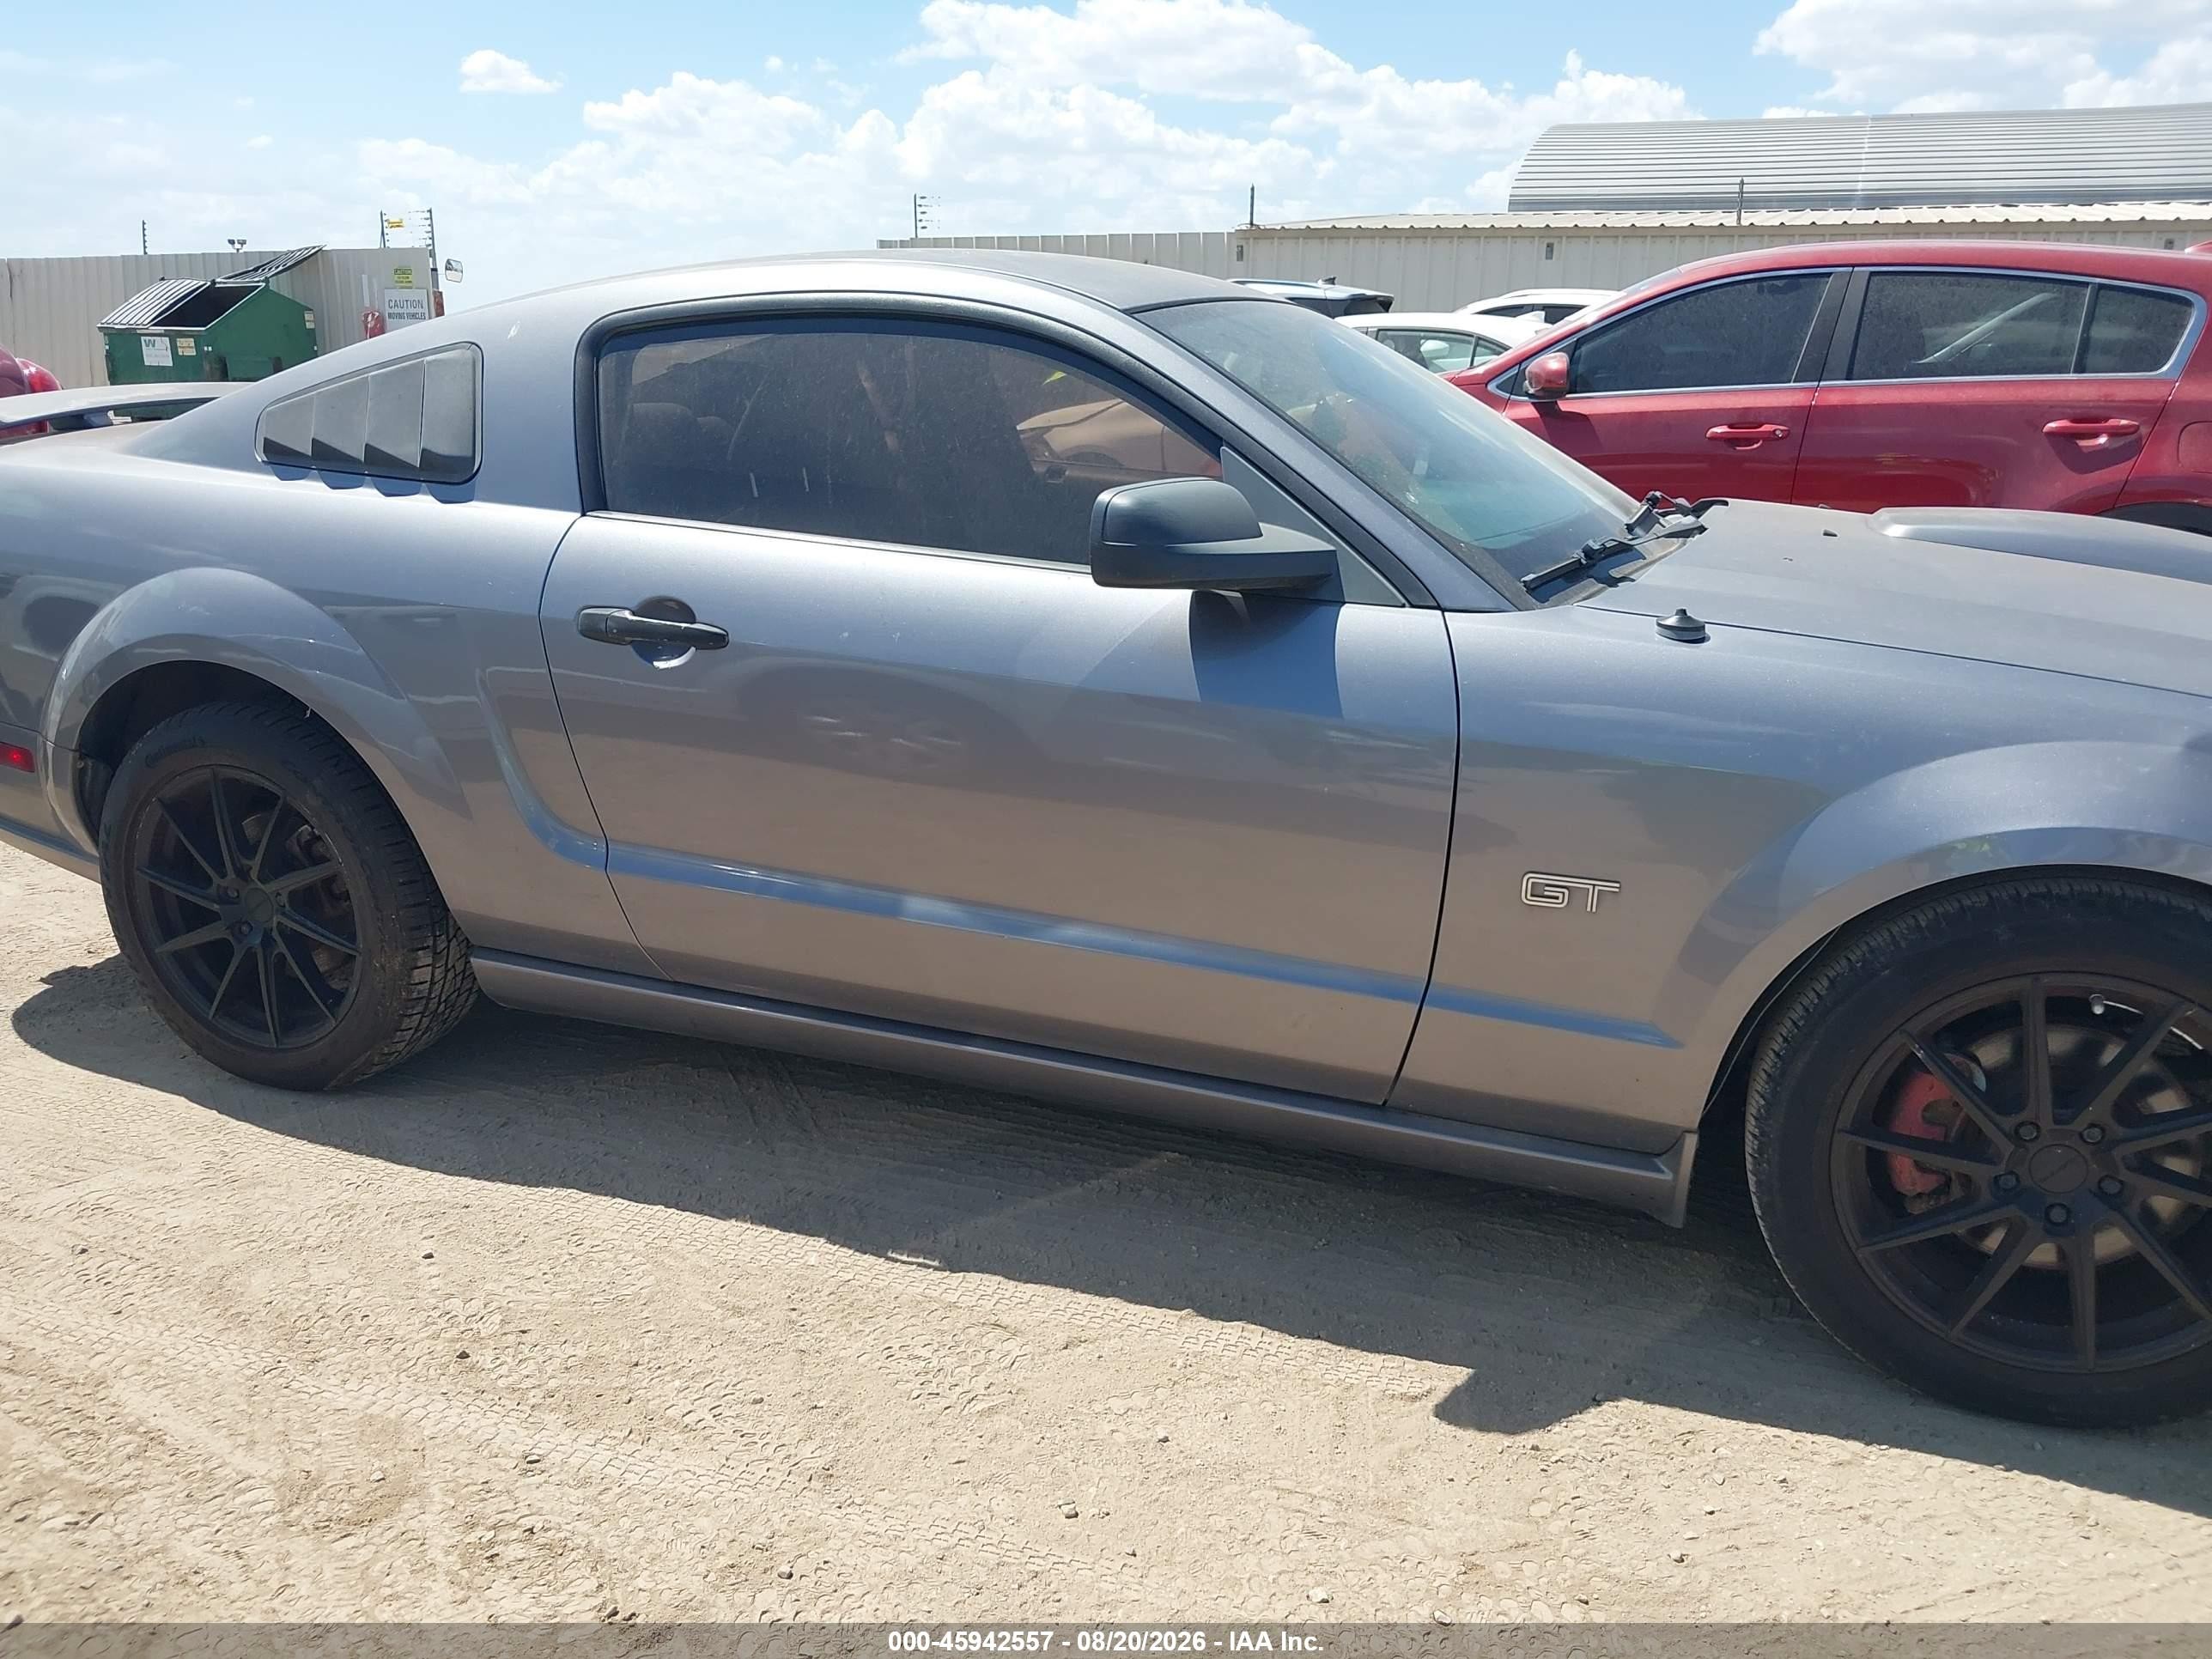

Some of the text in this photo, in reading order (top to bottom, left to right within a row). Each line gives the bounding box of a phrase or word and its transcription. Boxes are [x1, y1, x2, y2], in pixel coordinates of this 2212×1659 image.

[388, 299, 424, 309] CAUTION
[387, 312, 426, 320] MOVING VEHICLES
[1521, 871, 1621, 913] GT
